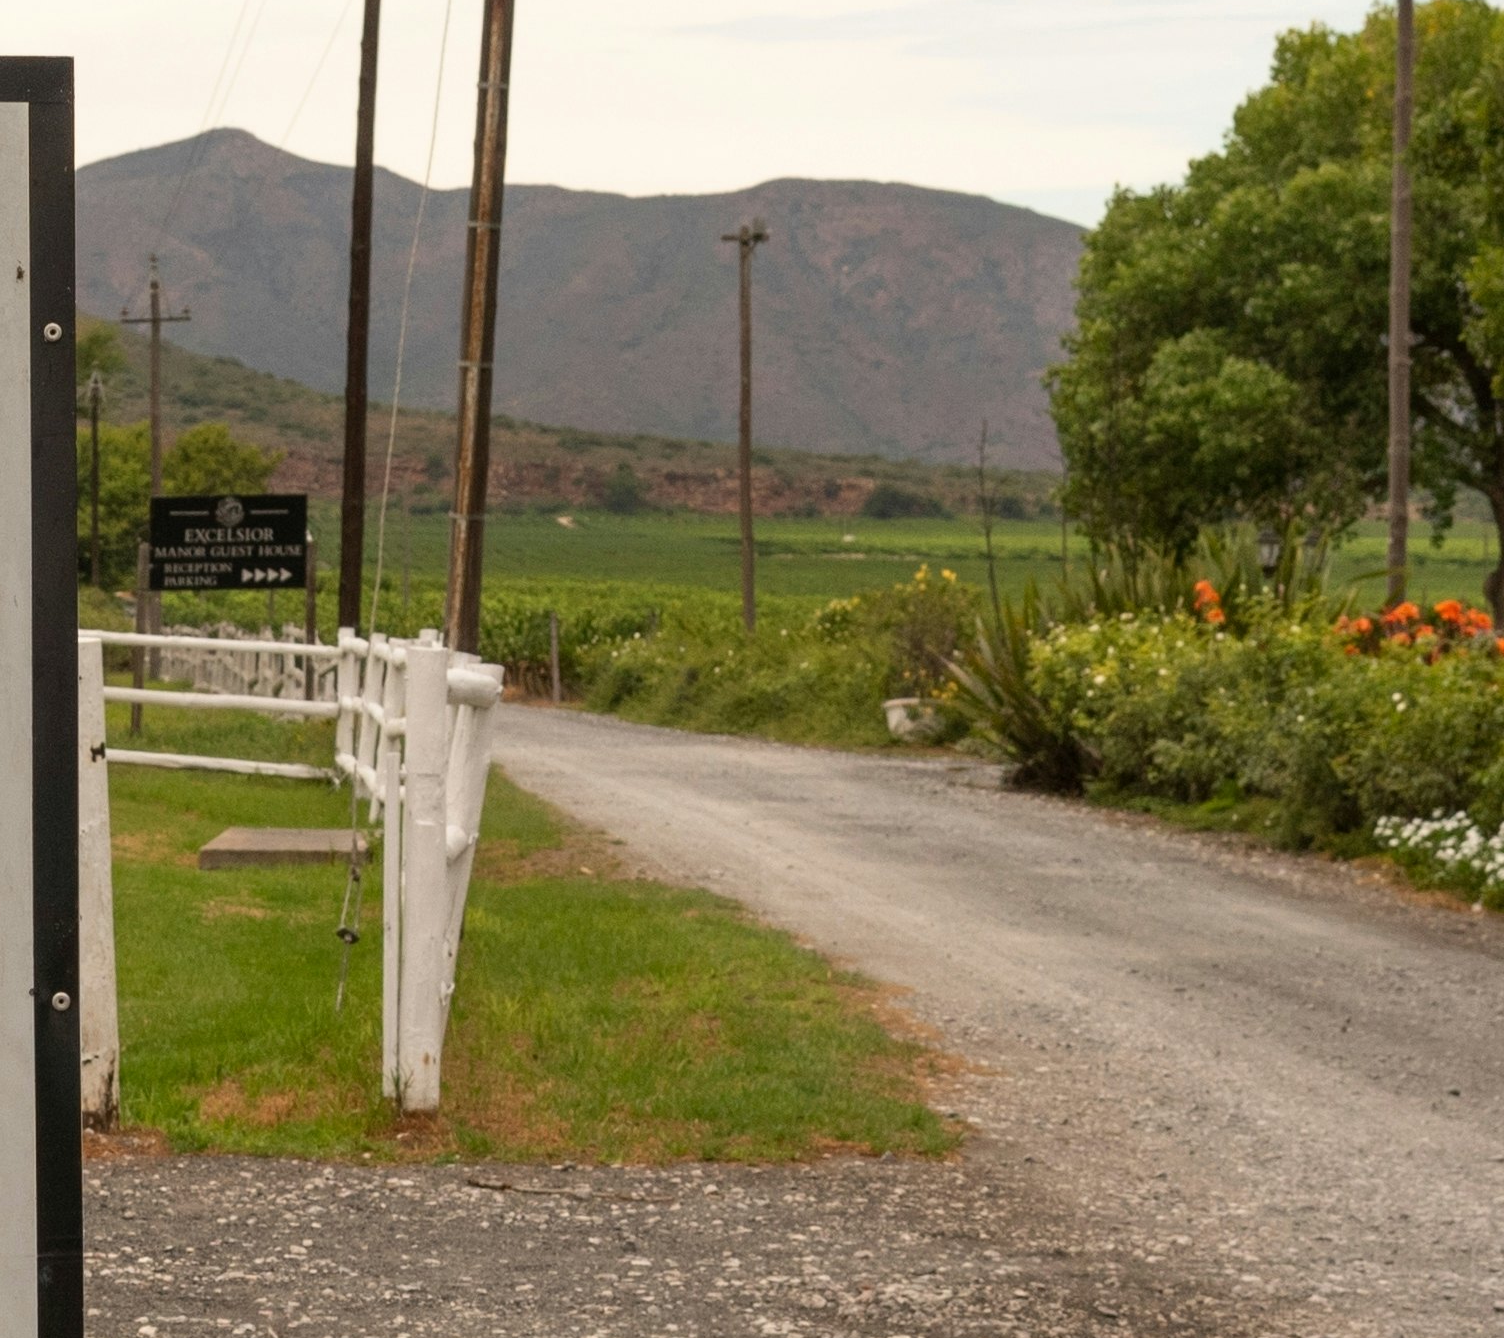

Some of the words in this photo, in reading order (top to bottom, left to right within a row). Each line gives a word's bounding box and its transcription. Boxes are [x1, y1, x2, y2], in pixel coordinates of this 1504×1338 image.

[184, 527, 275, 544] EXCELSIOR
[154, 546, 206, 558] MANOR
[210, 545, 253, 557] GUEST
[258, 544, 302, 556] HOUSE
[163, 562, 233, 574] RECEPTION
[163, 575, 218, 586] PARKING
